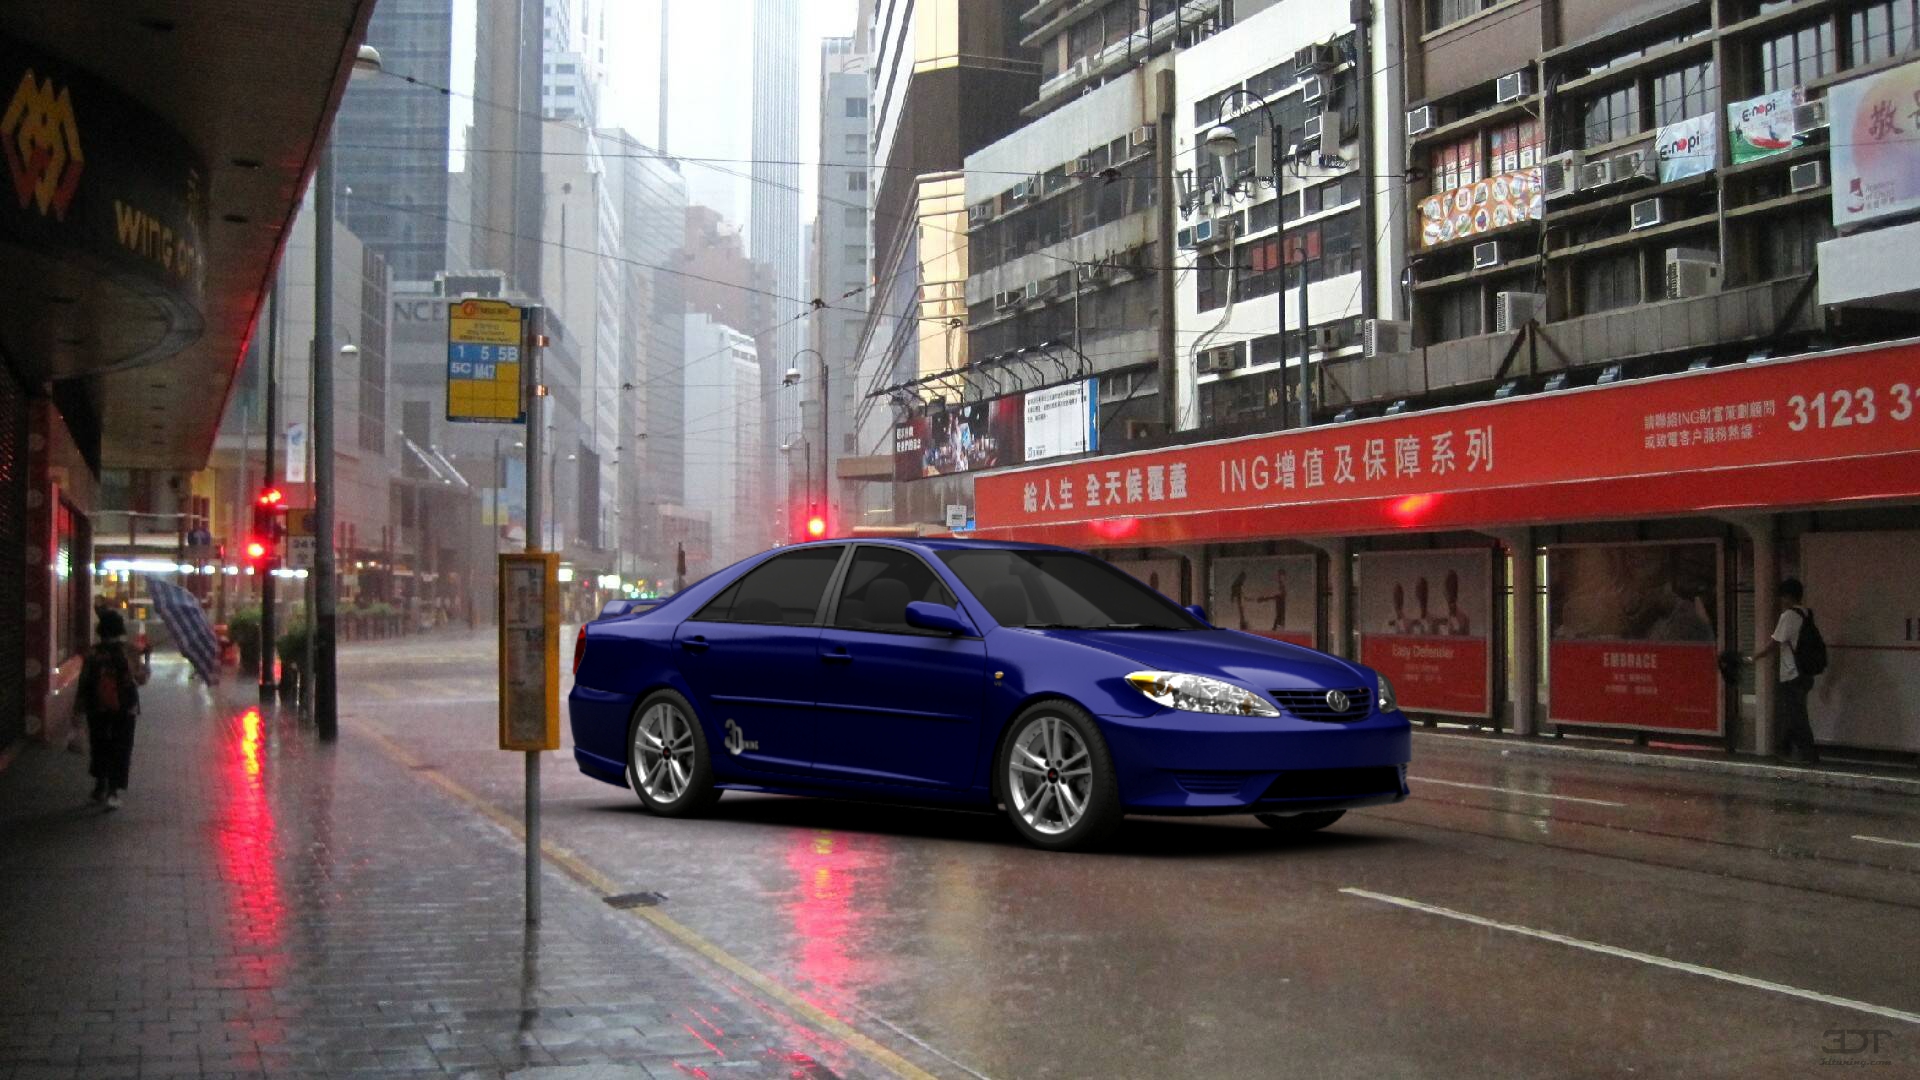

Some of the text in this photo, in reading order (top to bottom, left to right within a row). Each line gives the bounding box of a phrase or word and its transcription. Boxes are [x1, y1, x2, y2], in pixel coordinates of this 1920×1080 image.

[480, 346, 490, 360] 5
[498, 346, 519, 361] 5B
[1787, 383, 1920, 432] 3123 3
